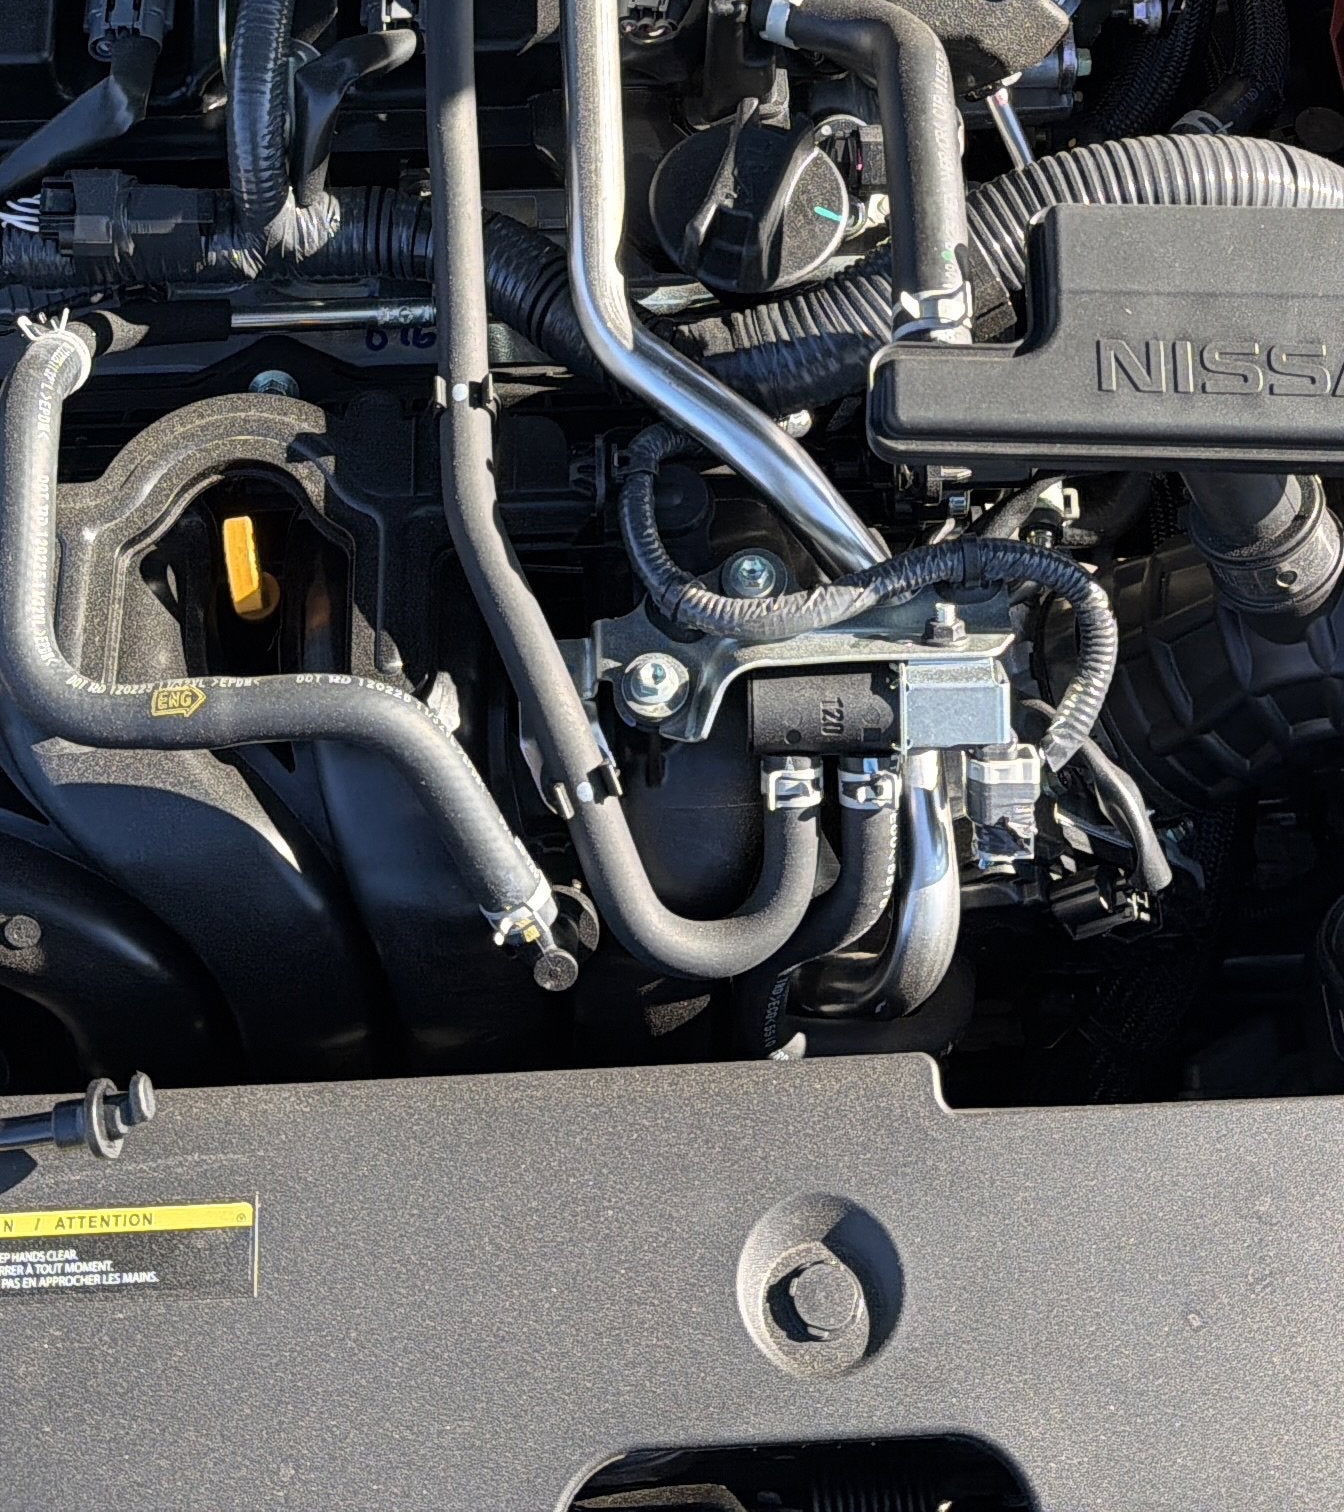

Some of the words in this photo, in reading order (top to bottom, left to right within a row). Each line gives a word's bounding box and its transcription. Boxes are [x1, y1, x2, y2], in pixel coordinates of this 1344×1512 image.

[158, 690, 193, 710] ENG
[55, 1212, 153, 1231] ATTENTION
[11, 1250, 45, 1263] HANDS
[24, 1260, 35, 1275] À
[36, 1262, 63, 1274] TOUT
[64, 1260, 114, 1273] MOMENT.
[1, 1278, 21, 1290] PAS
[22, 1276, 37, 1289] EN
[38, 1273, 101, 1287] APPROCHER
[102, 1272, 121, 1284] LES
[122, 1270, 160, 1283] MAINS.
